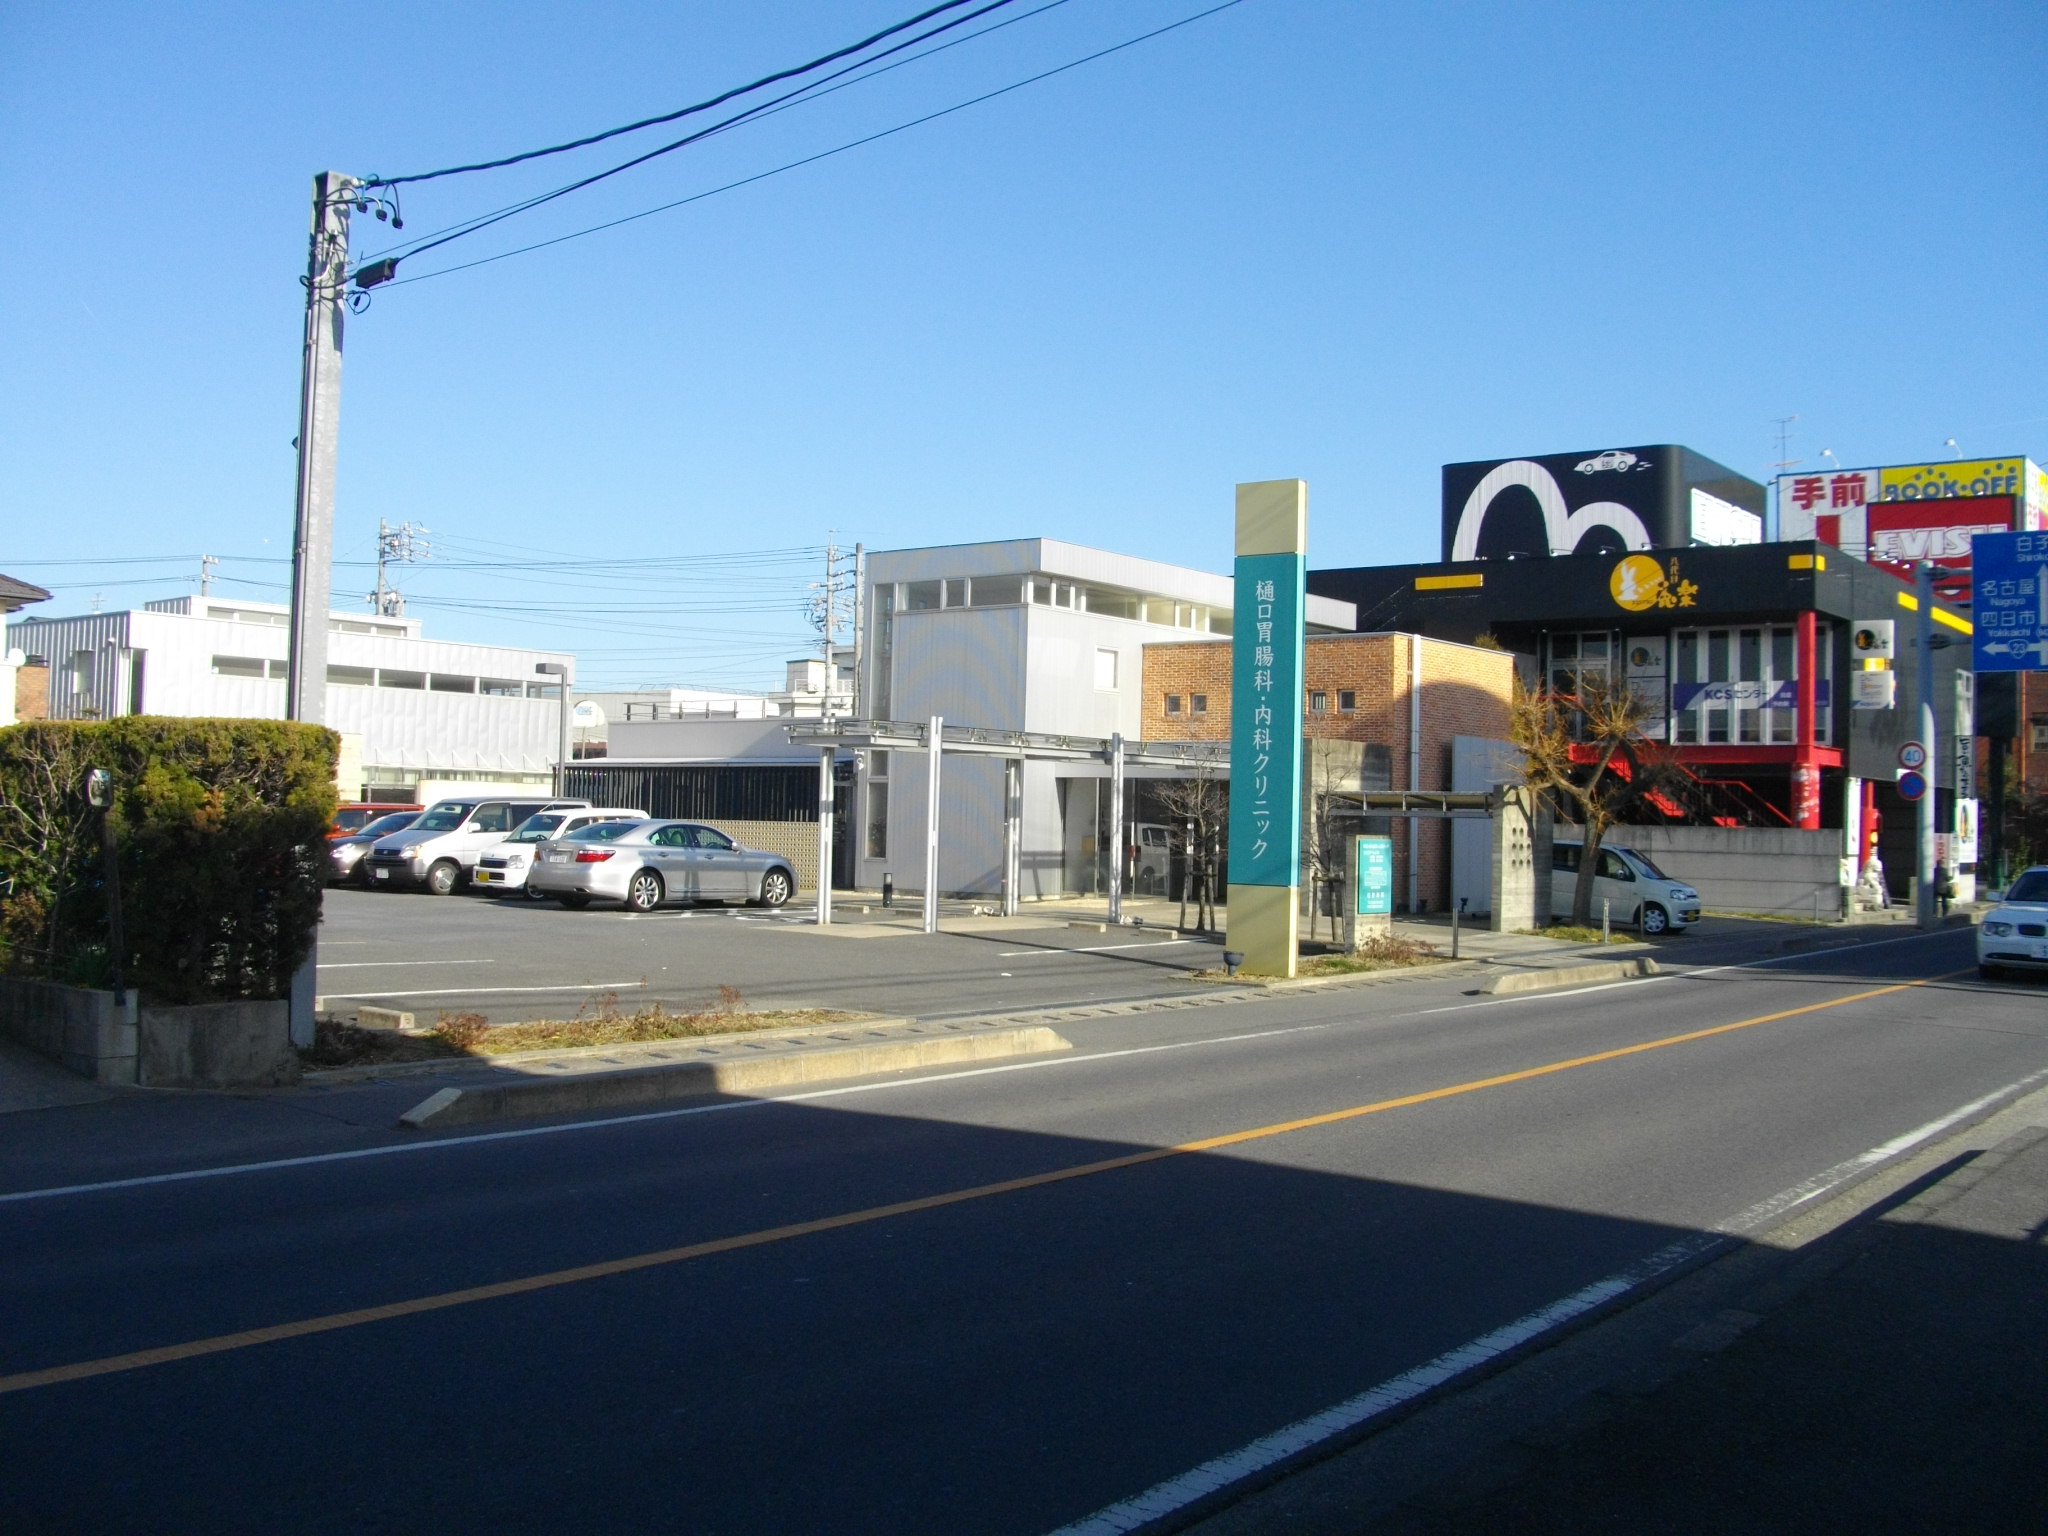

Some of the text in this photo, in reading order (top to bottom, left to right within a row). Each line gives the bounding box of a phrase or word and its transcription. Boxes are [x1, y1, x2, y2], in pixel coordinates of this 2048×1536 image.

[1792, 473, 1866, 510] 手前
[1873, 524, 2008, 562] EVIS
[1981, 579, 2035, 596] 名古屋
[1990, 597, 2026, 607] Nagoya
[1982, 610, 2035, 627] 四日市
[1988, 628, 2031, 637] Yokkaichi
[2013, 643, 2026, 654] 23
[1904, 750, 1921, 763] 40
